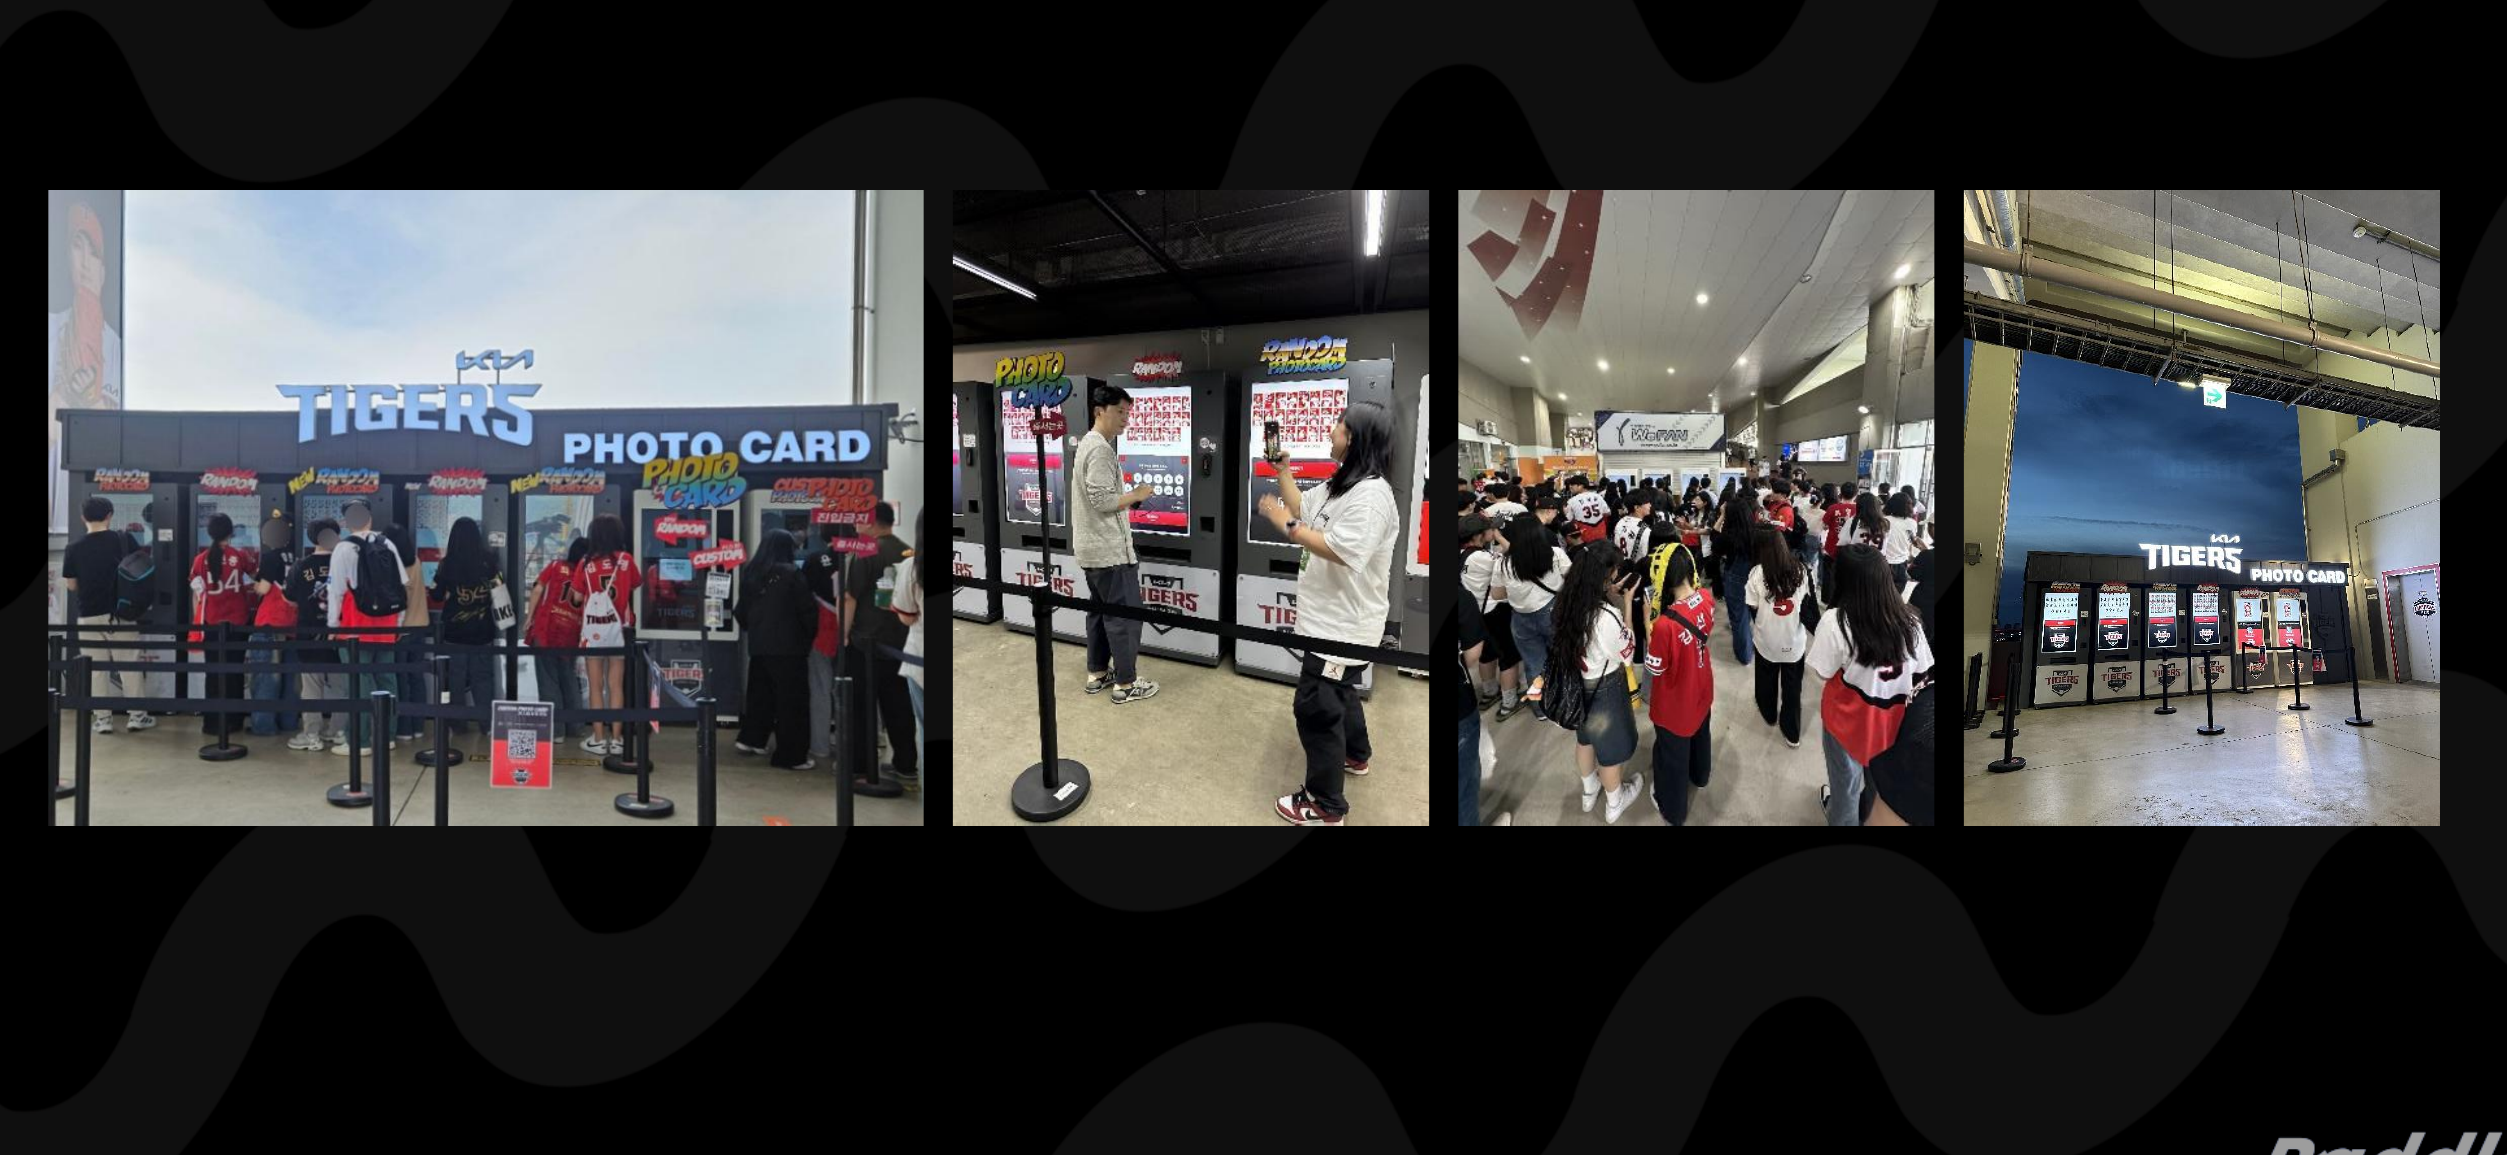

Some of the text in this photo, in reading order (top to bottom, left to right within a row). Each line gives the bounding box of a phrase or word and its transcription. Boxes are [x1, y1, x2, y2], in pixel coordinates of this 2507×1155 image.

[1259, 335, 1348, 362] RANDOM
[995, 351, 1065, 388] PHOTO
[1132, 361, 1182, 376] RANDOM
[1012, 377, 1072, 408] CARD
[276, 384, 542, 447] TIGERS
[564, 430, 871, 463] PHOTO CARD
[288, 467, 380, 495] NEW RANDOM
[510, 466, 605, 494] NEW RANDOM
[643, 452, 739, 488] PHOTO
[200, 473, 258, 490] RANDOM
[428, 475, 487, 490] RANDOM
[664, 476, 748, 509] CARD
[817, 512, 870, 524] 진입금지
[1582, 503, 1601, 519] 35
[656, 522, 707, 536] RANDOM
[693, 549, 743, 565] CUSTOM
[2139, 543, 2243, 575] TIGERS
[2251, 568, 2346, 584] PHOTO CARD
[2045, 675, 2079, 685] TIGERS
[2101, 671, 2133, 681] TIGERS
